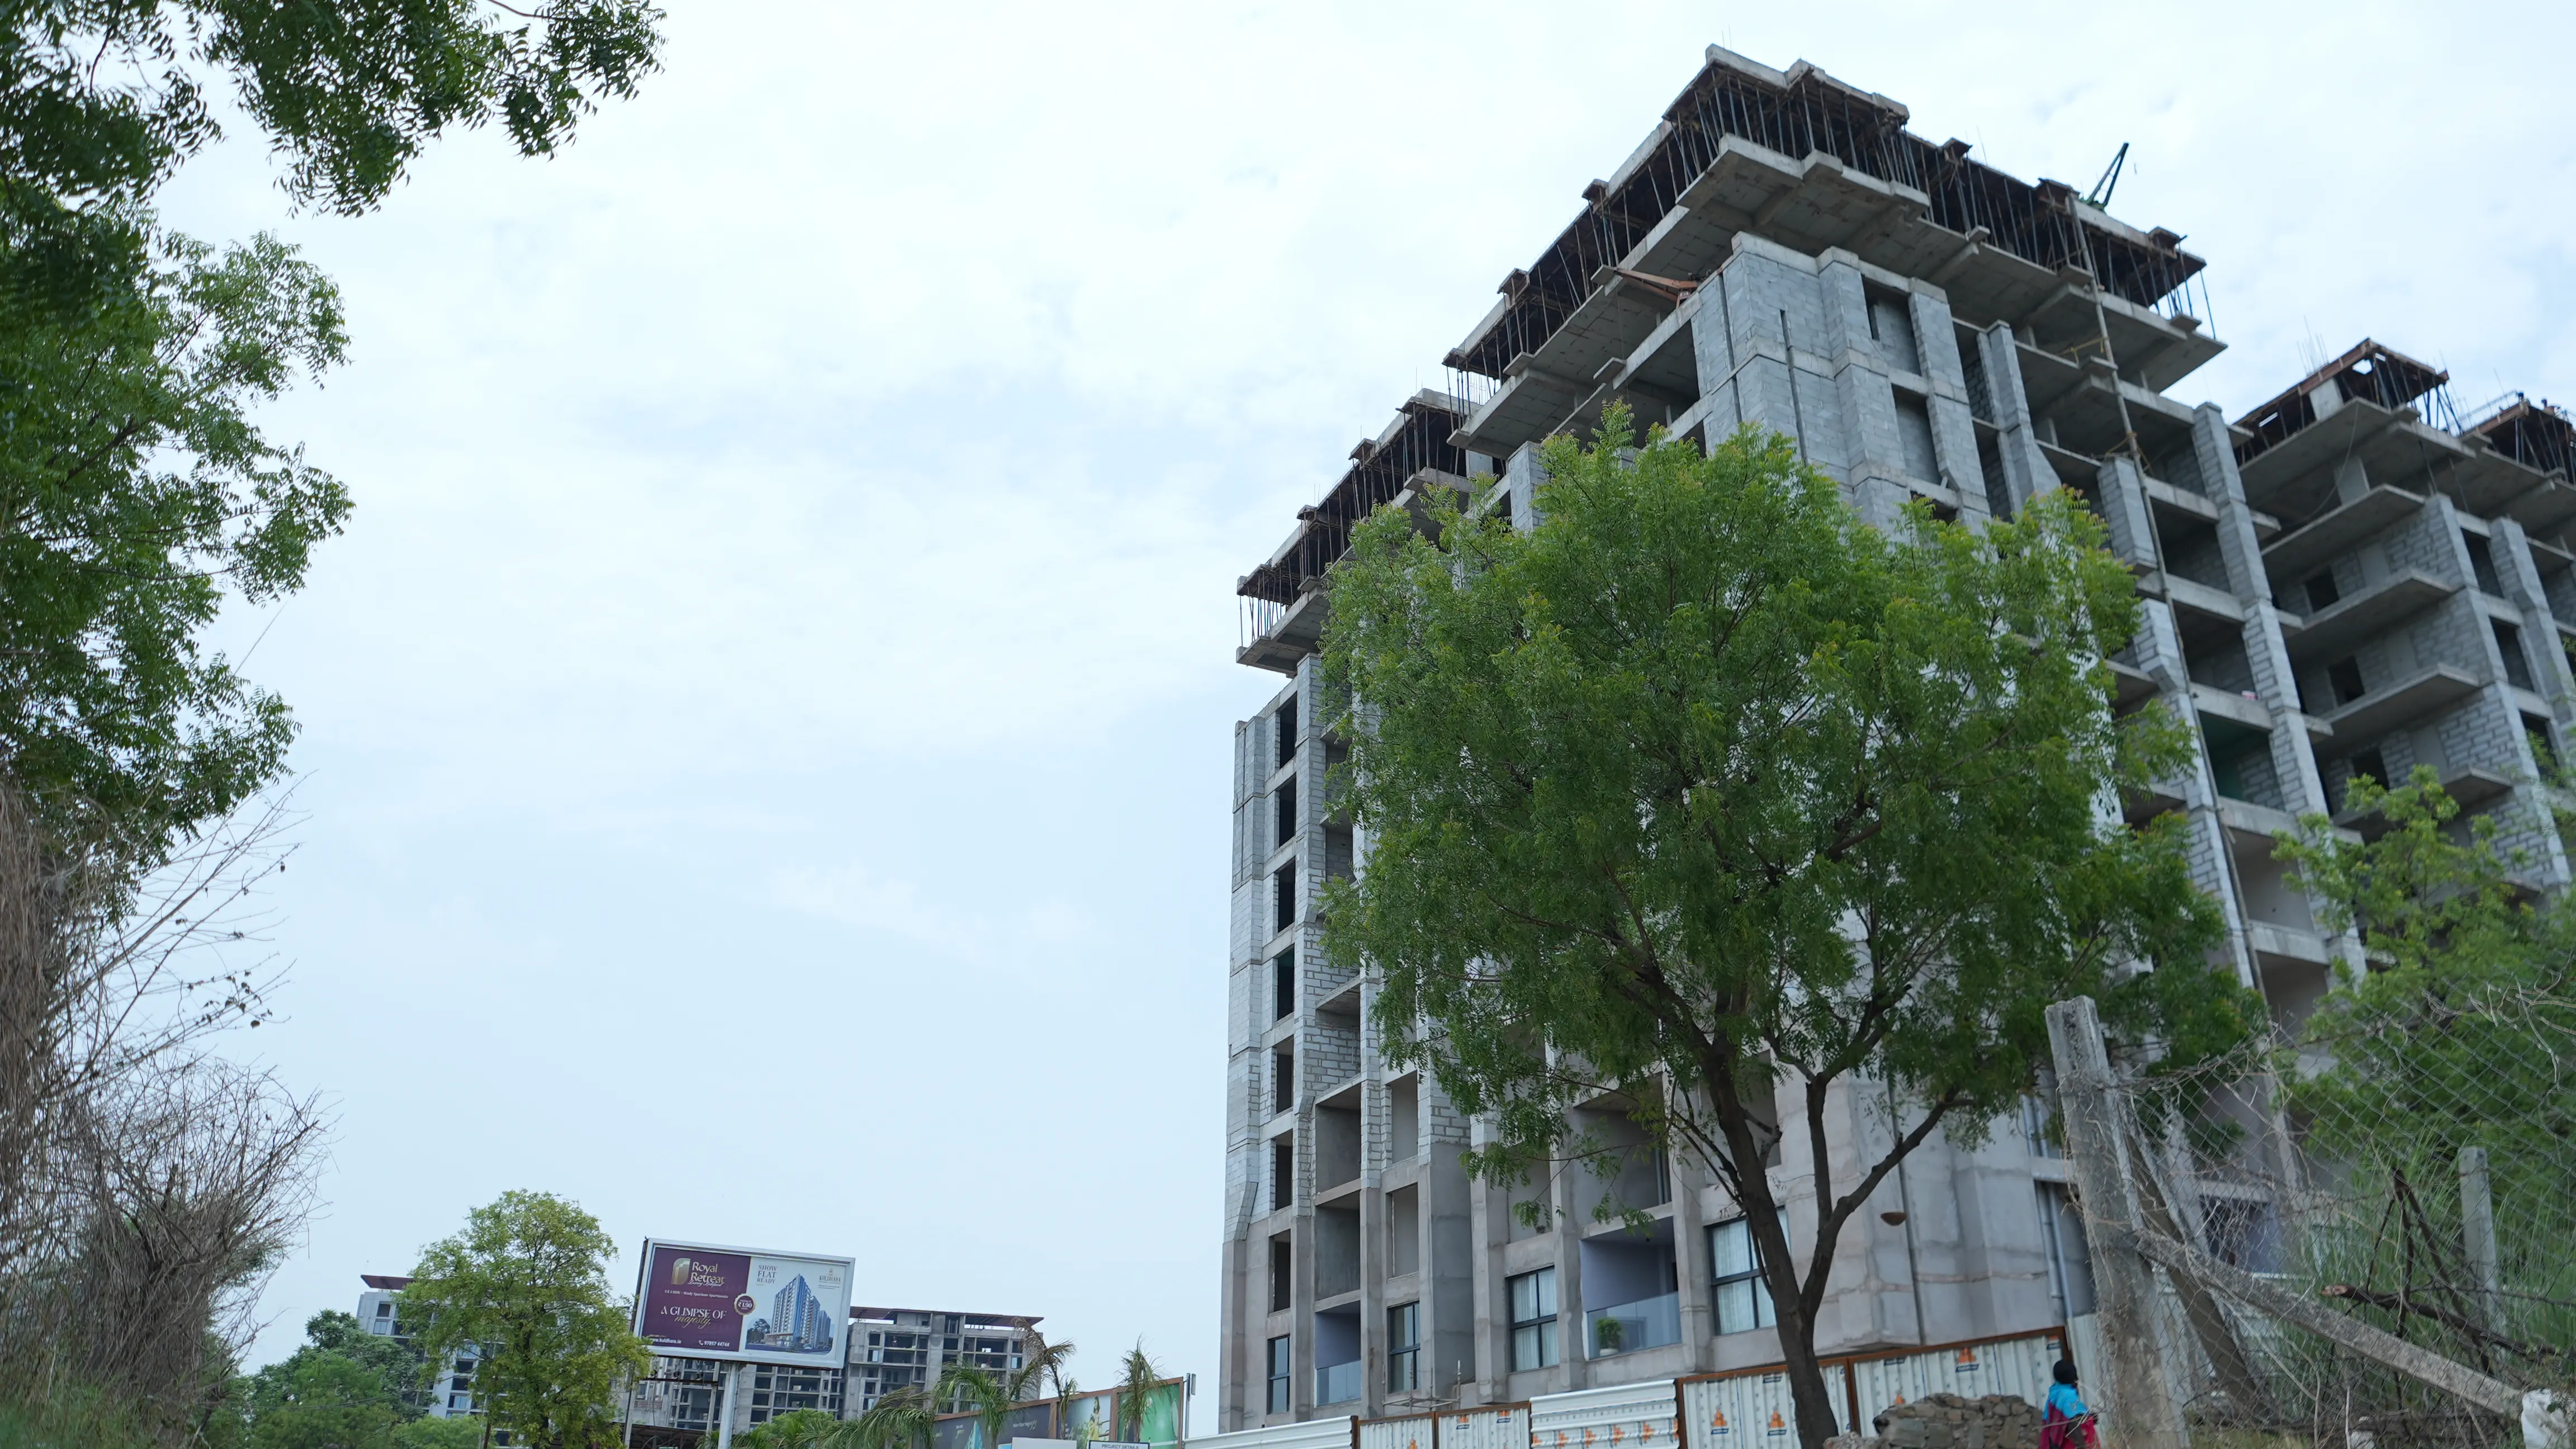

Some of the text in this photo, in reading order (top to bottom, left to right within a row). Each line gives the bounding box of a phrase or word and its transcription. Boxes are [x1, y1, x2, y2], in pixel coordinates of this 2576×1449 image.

[692, 1262, 718, 1275] Royal
[757, 1270, 777, 1278] FLAT
[690, 1272, 725, 1284] Retreat
[660, 1306, 727, 1319] A GLIMPSE OF
